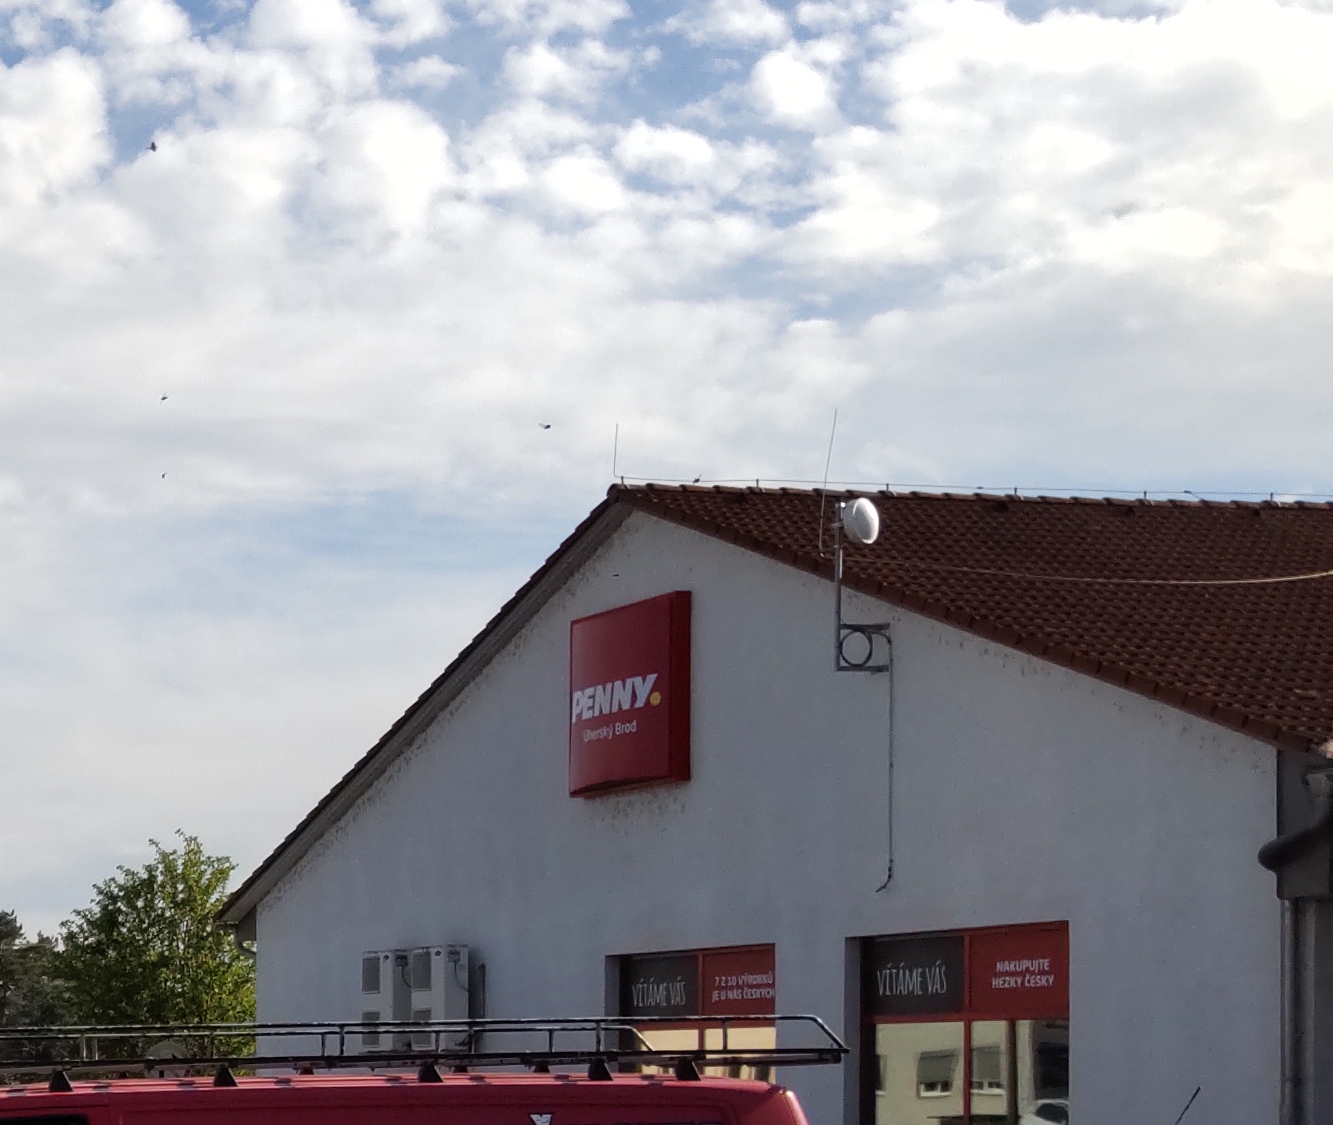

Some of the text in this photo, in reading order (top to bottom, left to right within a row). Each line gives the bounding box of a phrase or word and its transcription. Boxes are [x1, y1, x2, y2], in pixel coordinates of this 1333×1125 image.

[615, 719, 637, 735] Brod
[996, 958, 1050, 973] NAKUPUJTE
[877, 959, 947, 996] VÍTÁME VÁS
[992, 974, 1054, 988] HEZKY ČESKY
[632, 975, 686, 1007] VÍTÁME VÁS
